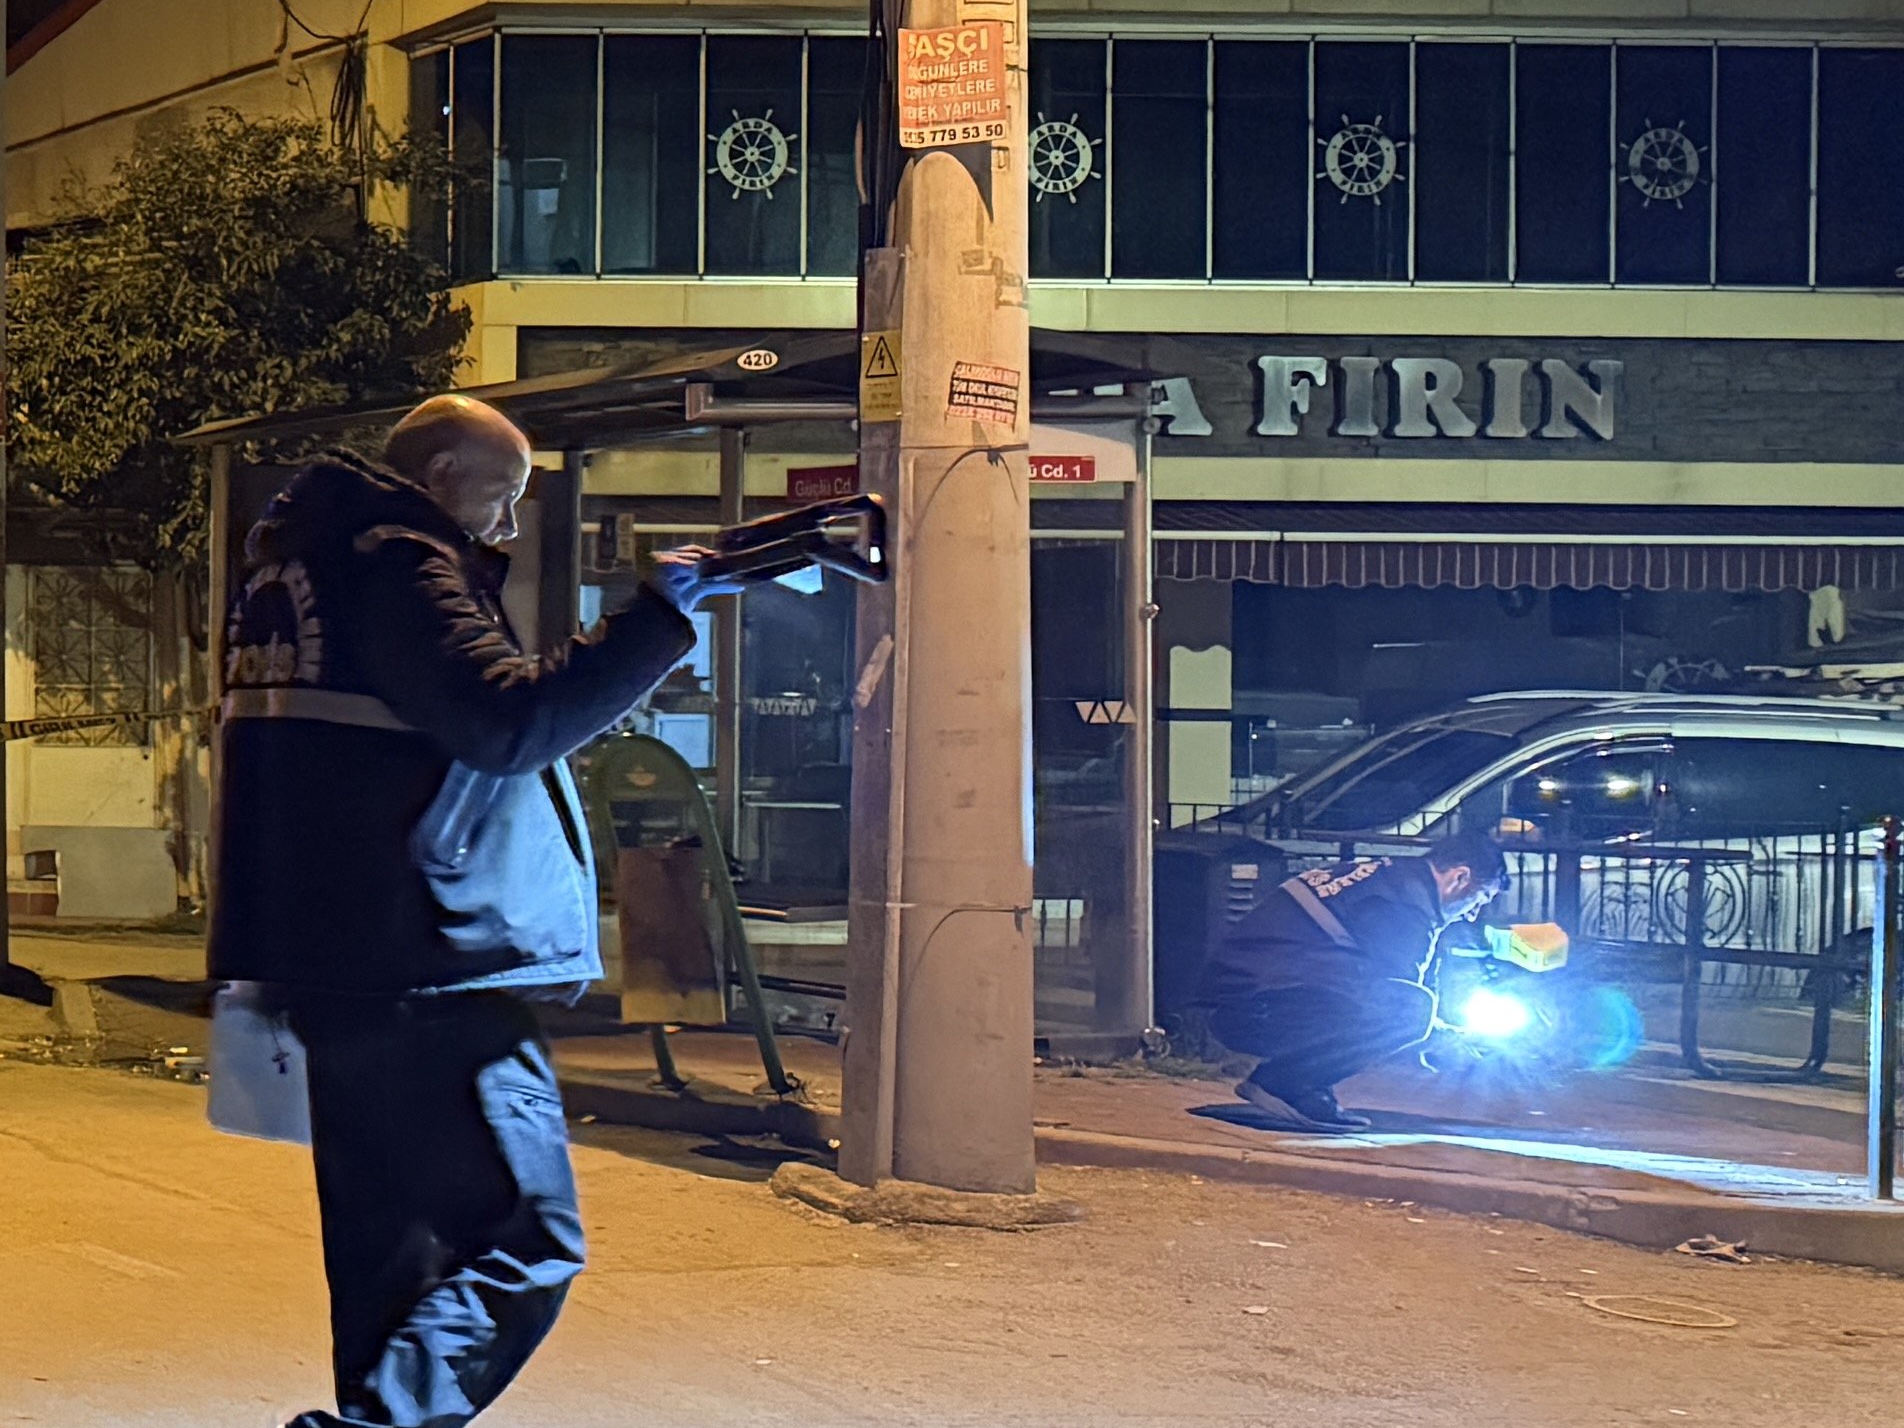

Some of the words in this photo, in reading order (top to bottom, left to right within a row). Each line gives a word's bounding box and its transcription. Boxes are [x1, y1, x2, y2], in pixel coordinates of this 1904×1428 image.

[915, 27, 989, 61] AŞÇI
[943, 98, 1001, 118] YAPILIR
[930, 128, 957, 142] 779
[962, 126, 980, 139] 53
[985, 123, 1004, 136] 50
[743, 353, 772, 366] 420
[1256, 355, 1624, 440] FIRIN
[1042, 464, 1068, 479] Cd.
[1073, 464, 1081, 478] 1
